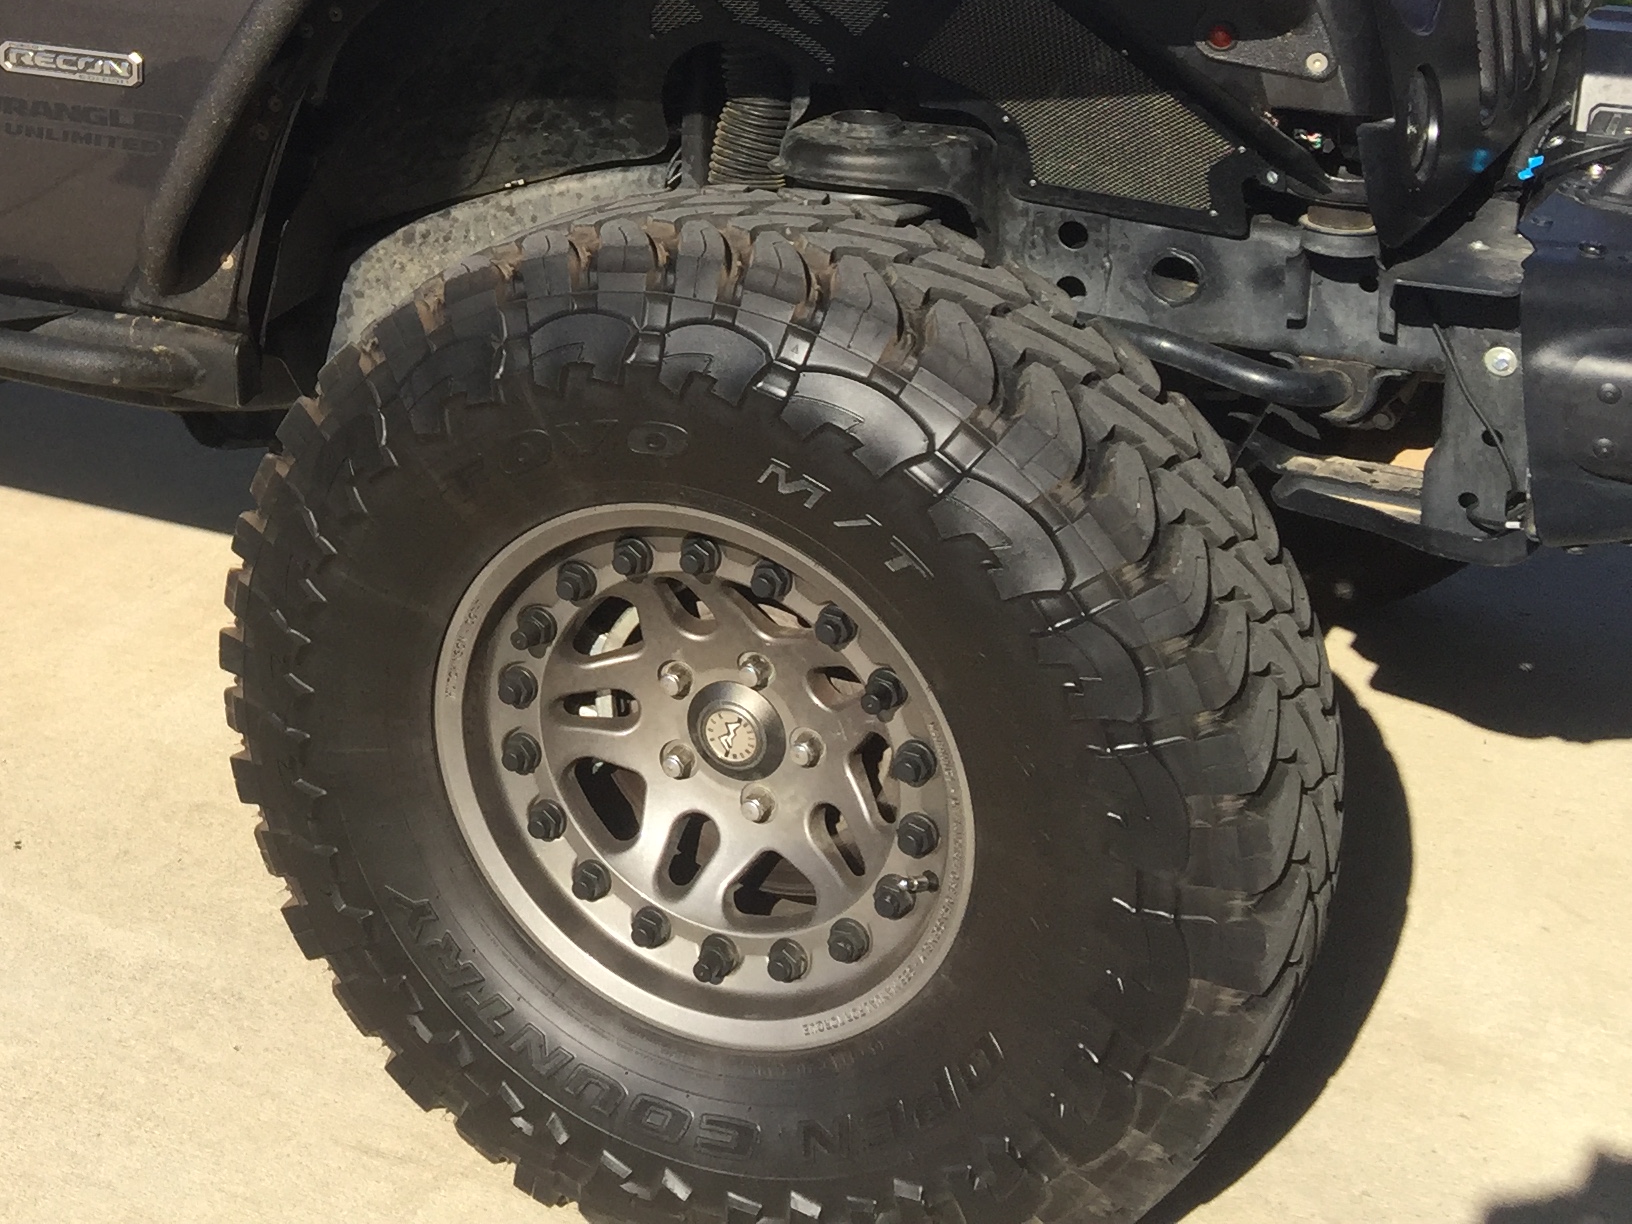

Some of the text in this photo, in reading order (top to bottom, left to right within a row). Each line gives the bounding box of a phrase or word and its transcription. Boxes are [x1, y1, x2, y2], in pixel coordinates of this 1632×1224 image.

[8, 48, 131, 77] RECON
[757, 458, 935, 580] M/T
[383, 884, 762, 1160] COUNTRY
